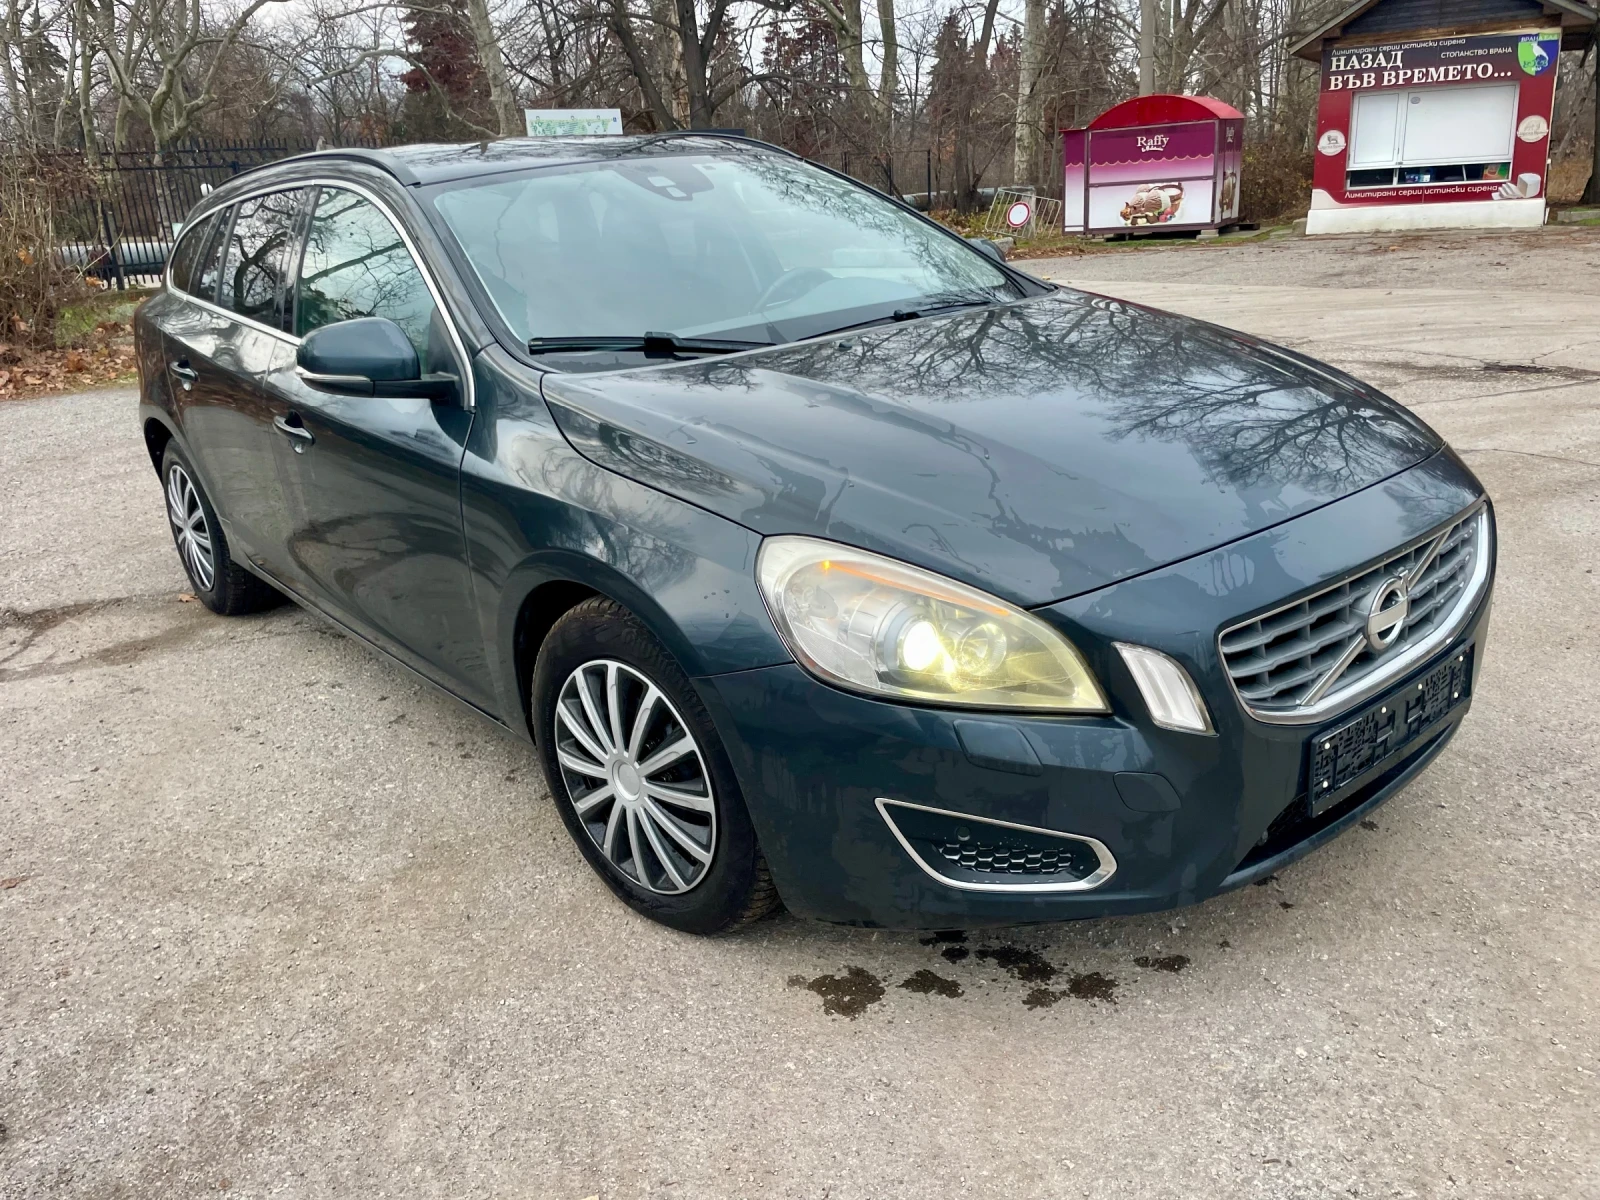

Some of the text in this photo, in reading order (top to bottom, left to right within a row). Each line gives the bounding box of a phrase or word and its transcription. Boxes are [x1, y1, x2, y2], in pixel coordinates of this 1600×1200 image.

[1379, 44, 1400, 53] серии
[1440, 38, 1466, 47] сирена
[1441, 46, 1512, 59] СТОПАНСТВО ВРАНА
[1329, 51, 1404, 71] НАЗАД
[1328, 72, 1376, 91] ВЪВ
[1381, 62, 1512, 86] ВРЕМЕТО...
[1136, 134, 1170, 148] Raffy
[1344, 184, 1498, 199] Лимитирани серии истински сирена
